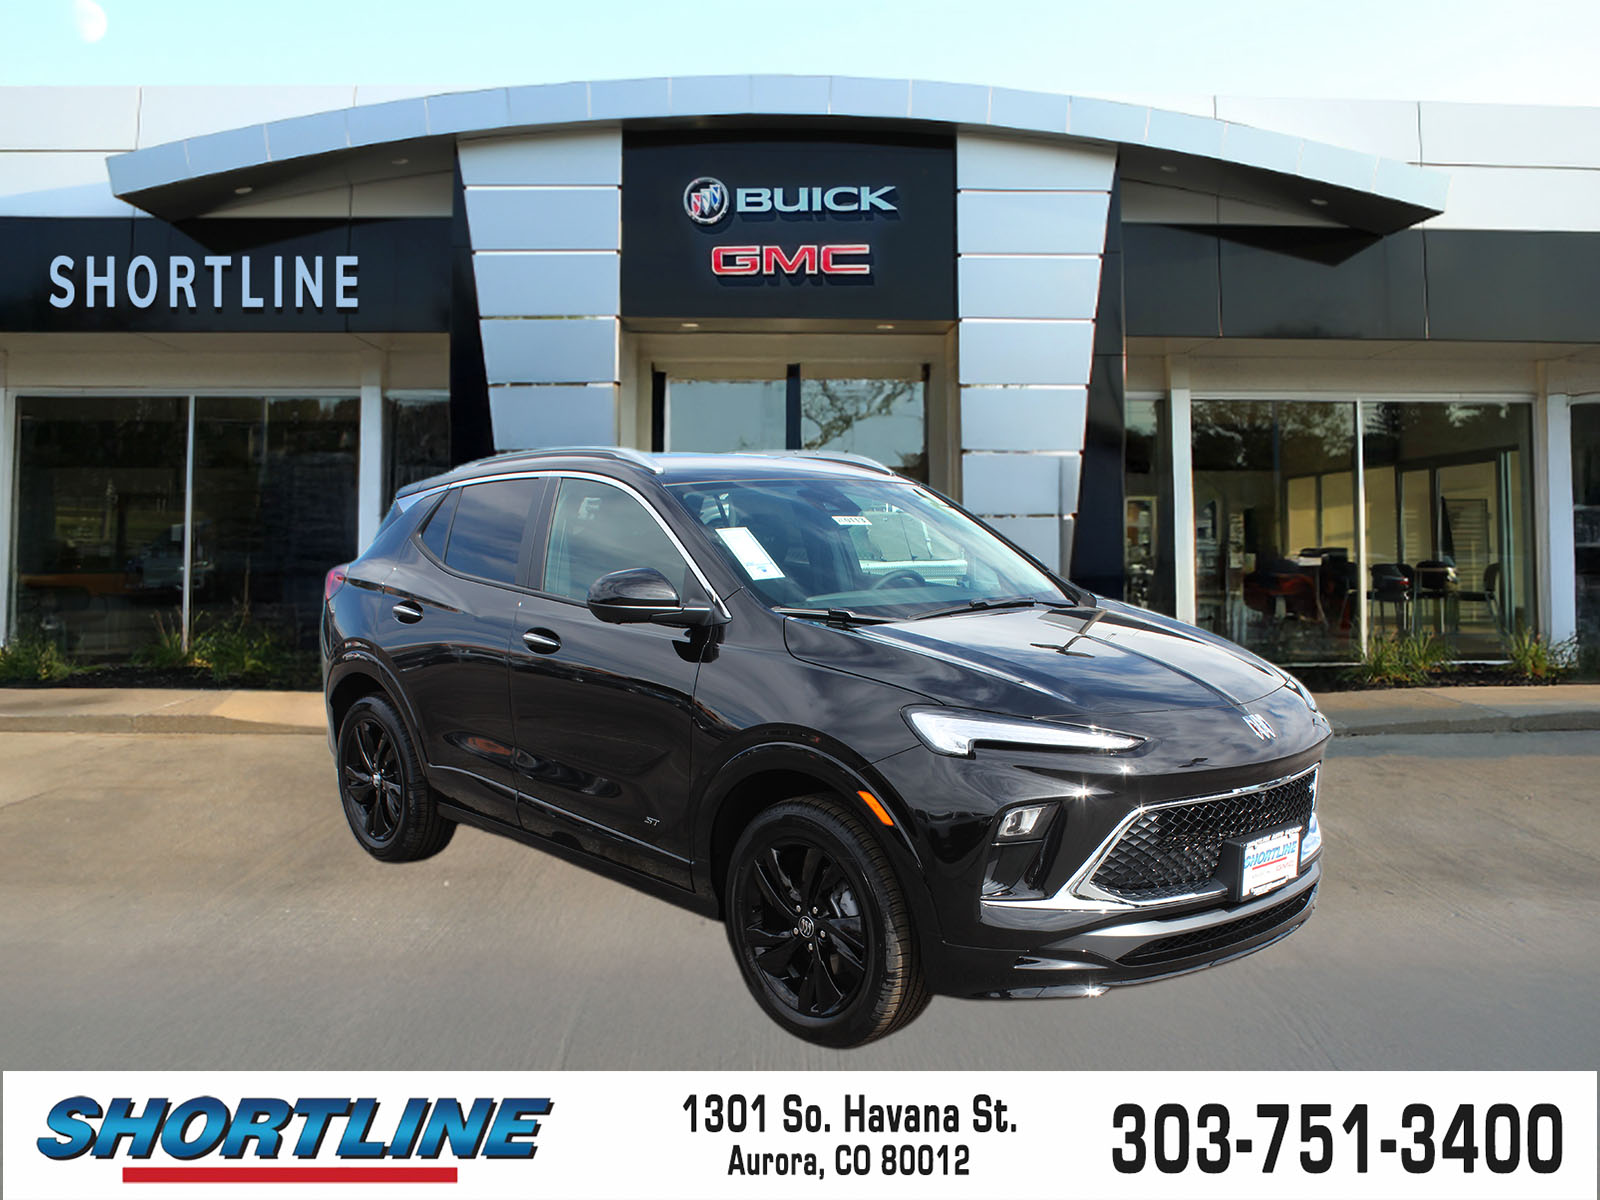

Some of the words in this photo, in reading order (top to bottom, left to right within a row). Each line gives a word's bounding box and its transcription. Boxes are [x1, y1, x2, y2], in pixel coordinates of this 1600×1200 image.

[736, 186, 898, 212] BUICK
[711, 244, 870, 276] GMC
[49, 255, 359, 308] SHORTLINE
[1243, 841, 1298, 870] SHORTLINE
